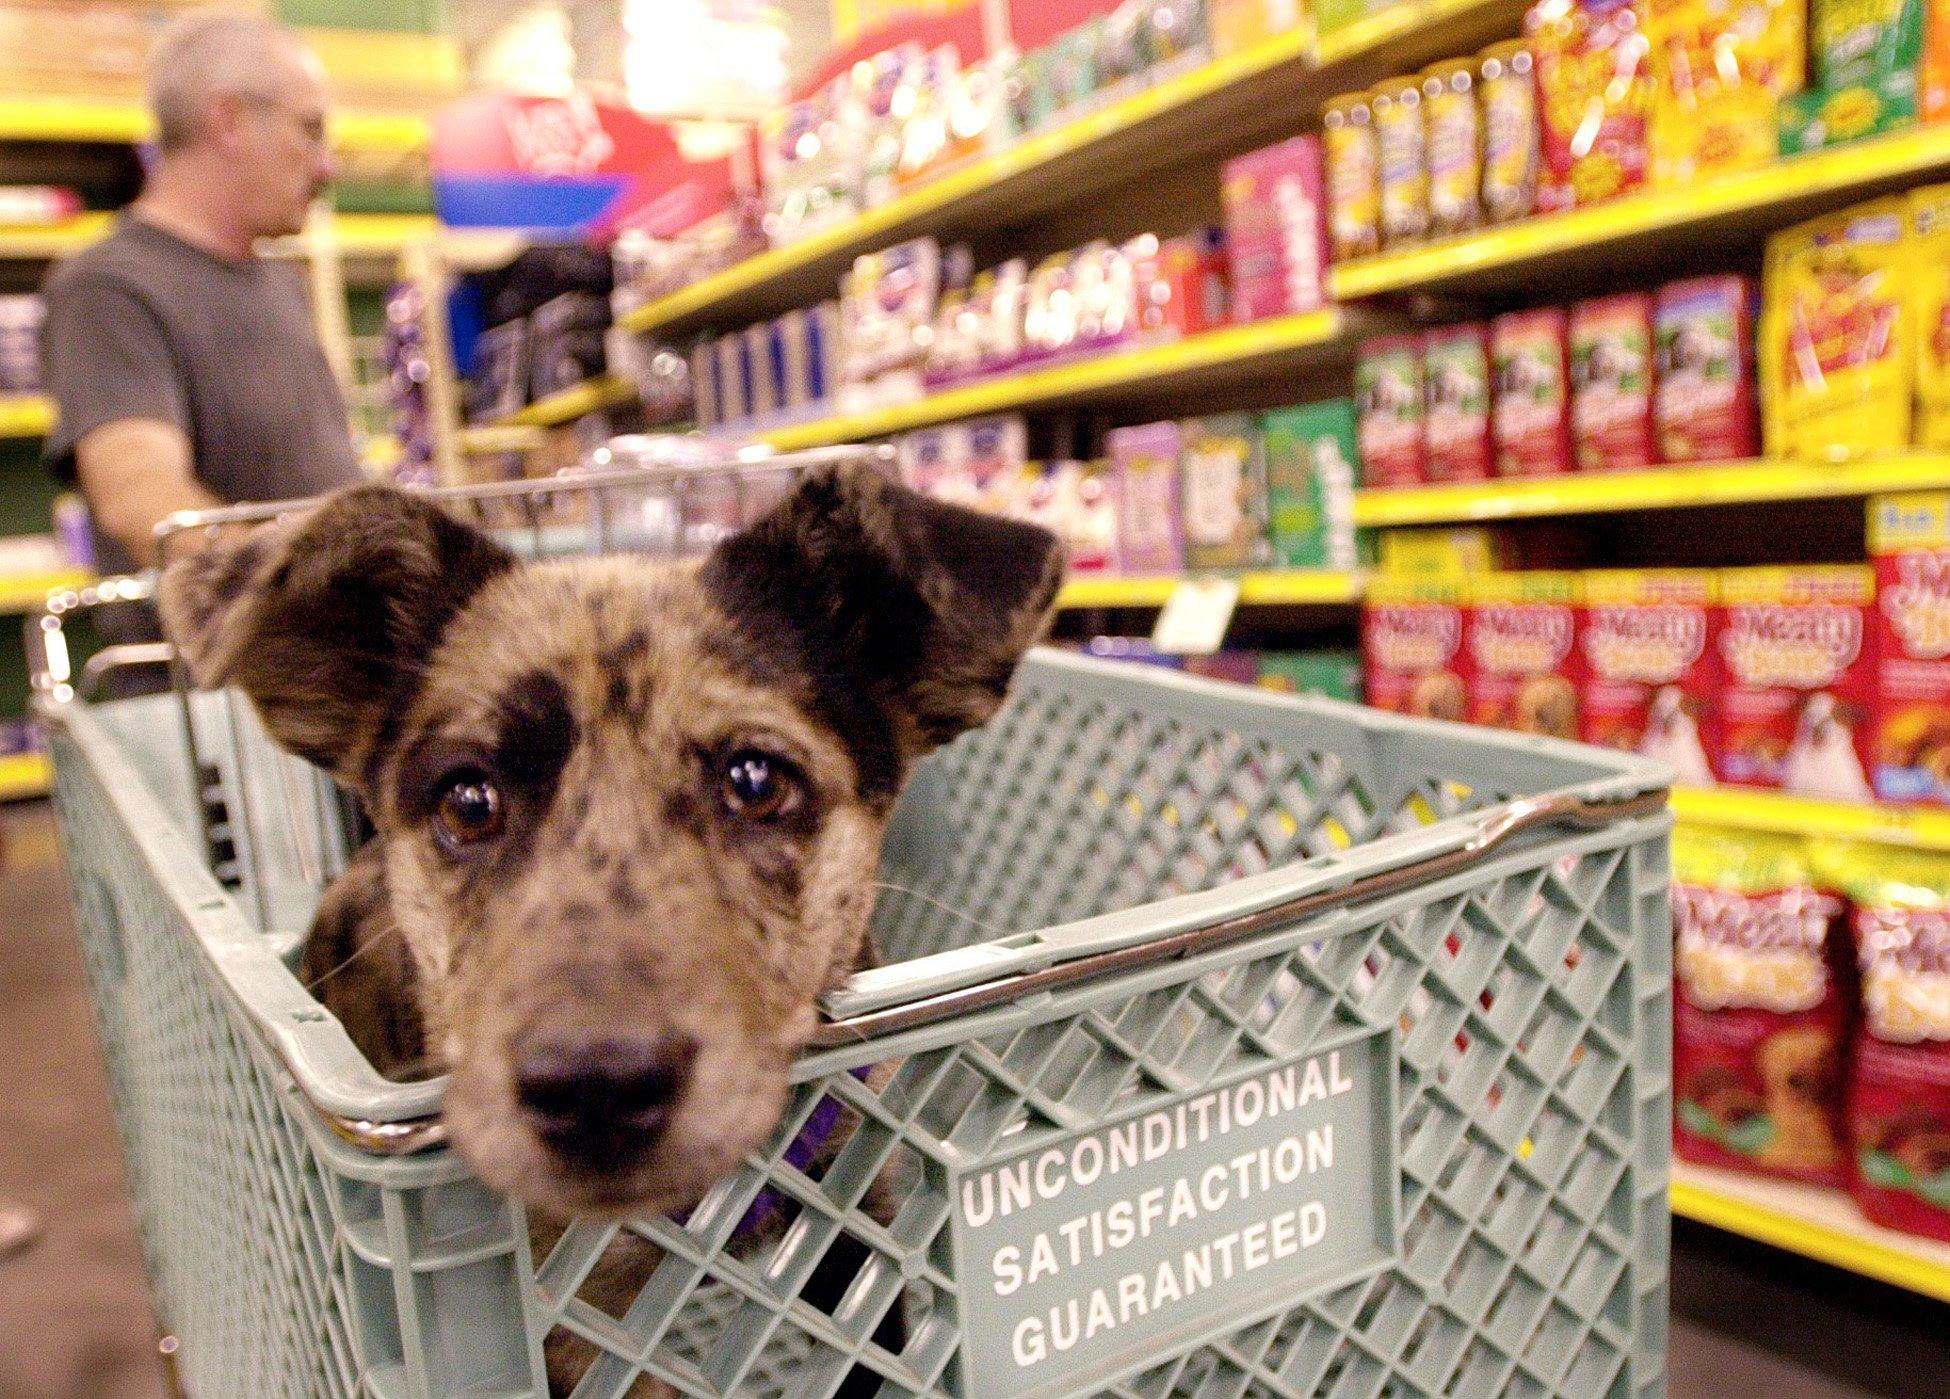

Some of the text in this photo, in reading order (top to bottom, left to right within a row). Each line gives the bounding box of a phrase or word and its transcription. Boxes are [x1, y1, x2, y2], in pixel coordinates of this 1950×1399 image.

[962, 1052, 1352, 1228] UNCONDITIONAL
[992, 1125, 1334, 1296] SATISFACTION
[1011, 1201, 1328, 1367] GUARANTEED
